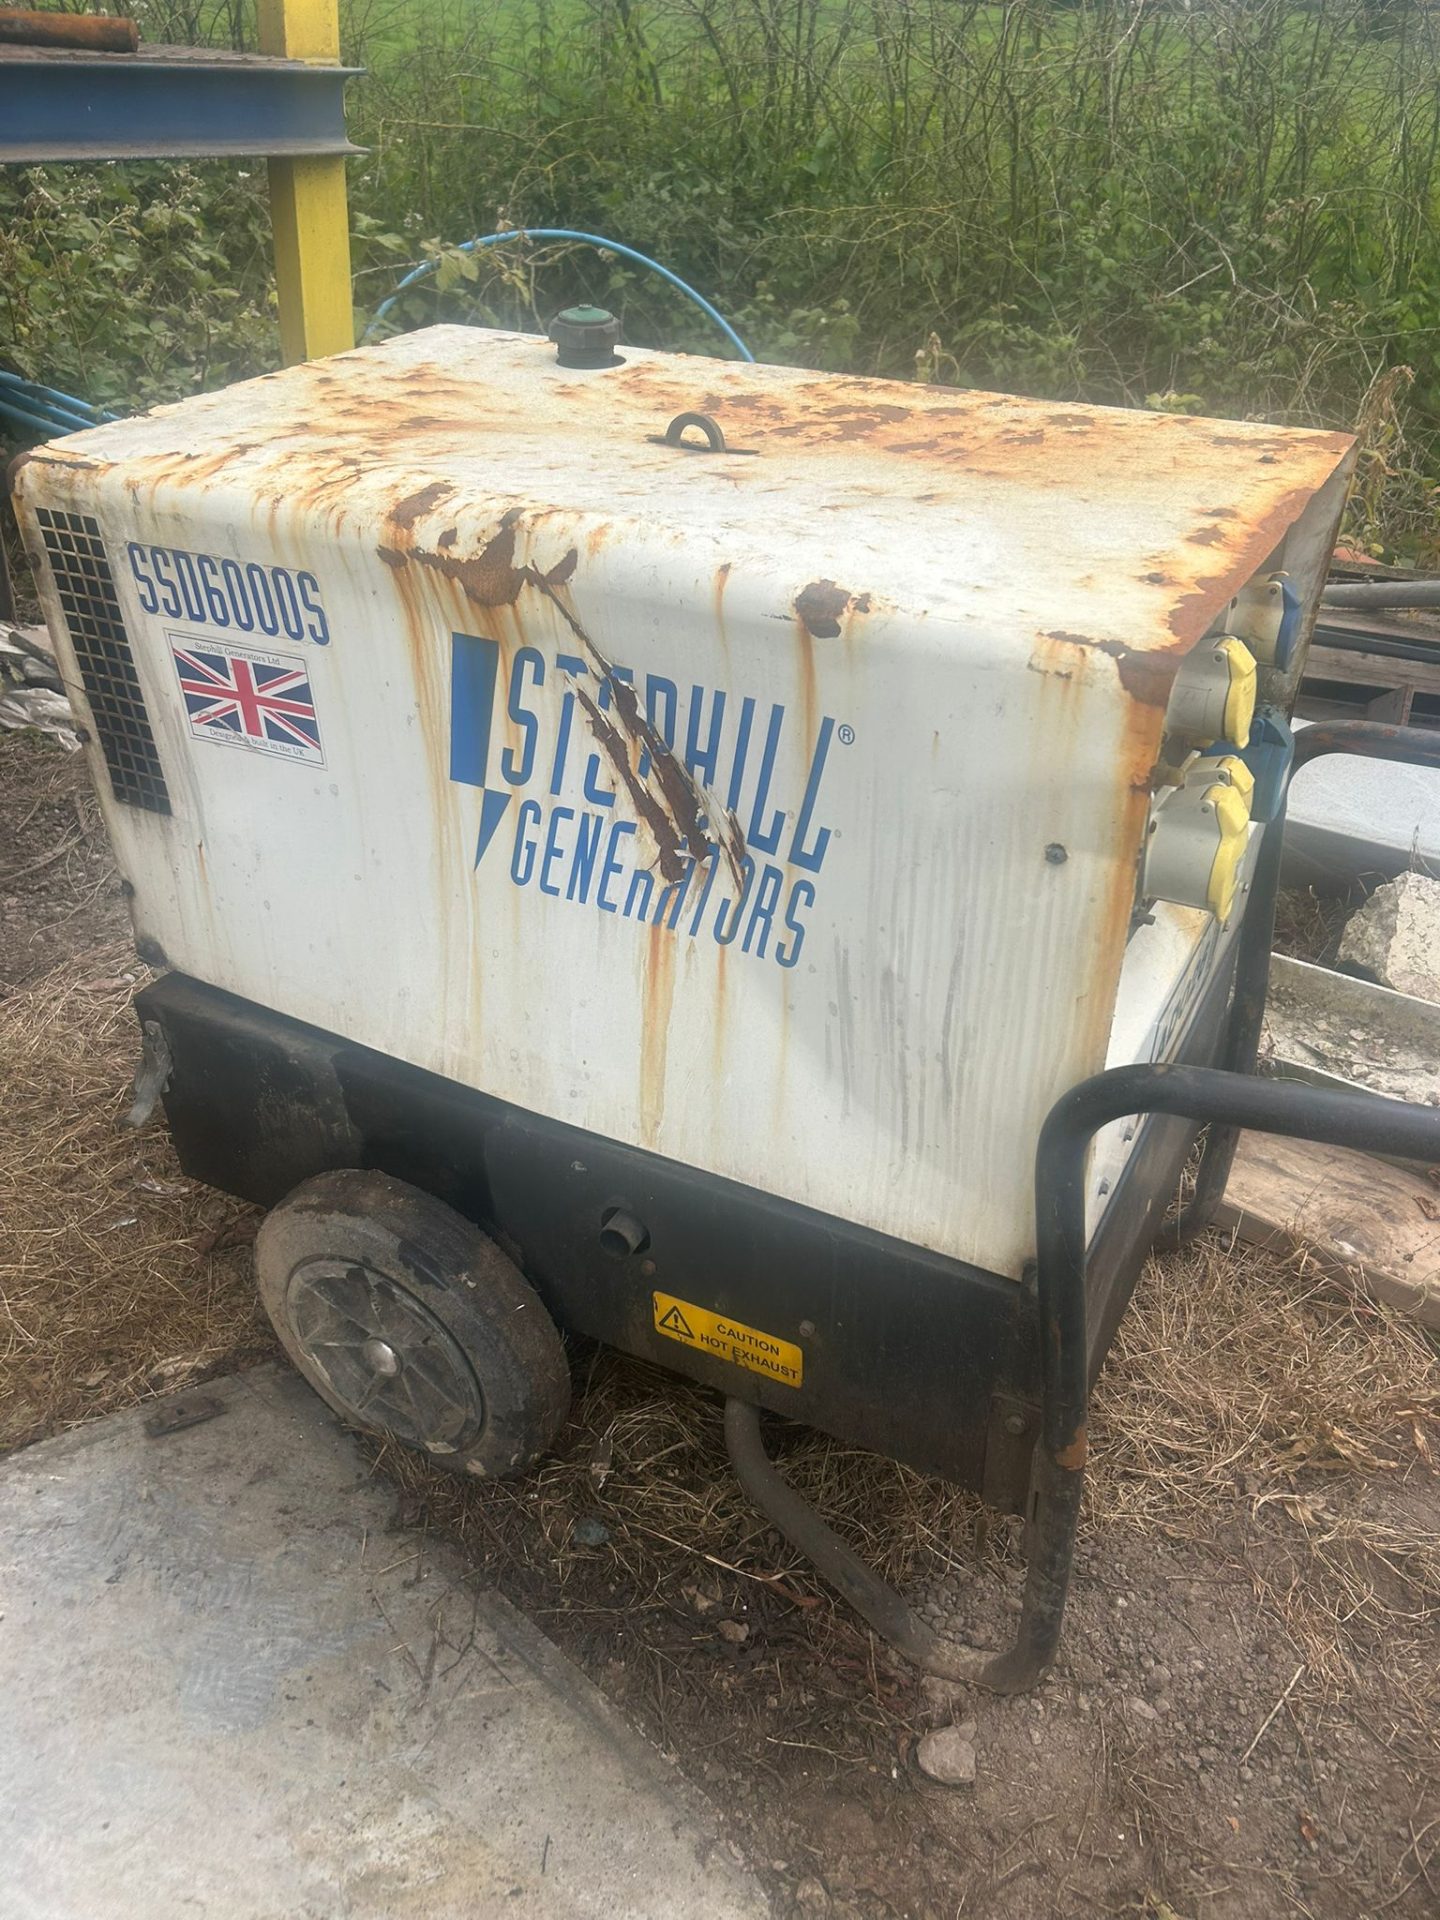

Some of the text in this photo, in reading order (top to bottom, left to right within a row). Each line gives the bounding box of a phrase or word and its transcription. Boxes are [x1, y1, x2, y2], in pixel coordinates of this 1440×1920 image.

[127, 541, 330, 646] SSD6000S
[193, 642, 223, 655] Stephill
[224, 647, 266, 663] Generators
[279, 744, 292, 753] the
[292, 747, 305, 757] UK
[716, 1323, 780, 1356] CAUTION
[700, 1333, 799, 1380] HOT EXHAUST
